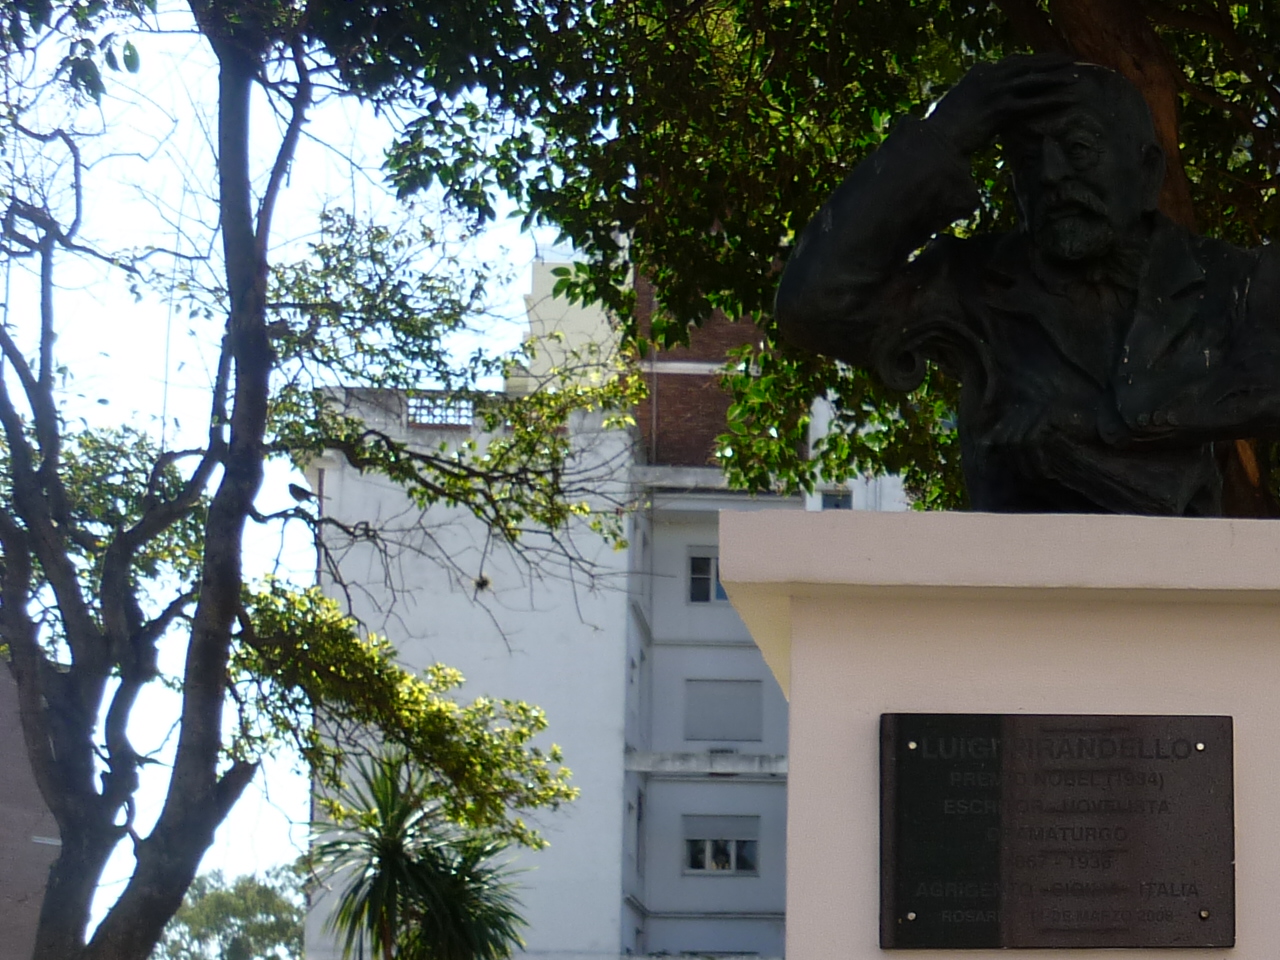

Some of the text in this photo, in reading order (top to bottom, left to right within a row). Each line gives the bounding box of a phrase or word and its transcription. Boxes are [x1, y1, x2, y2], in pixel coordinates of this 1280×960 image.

[1010, 738, 1193, 760] PIRANDELLO
[950, 771, 1027, 787] PREMO
[943, 799, 1044, 814] ESCROR
[1139, 882, 1200, 898] ITALIA
